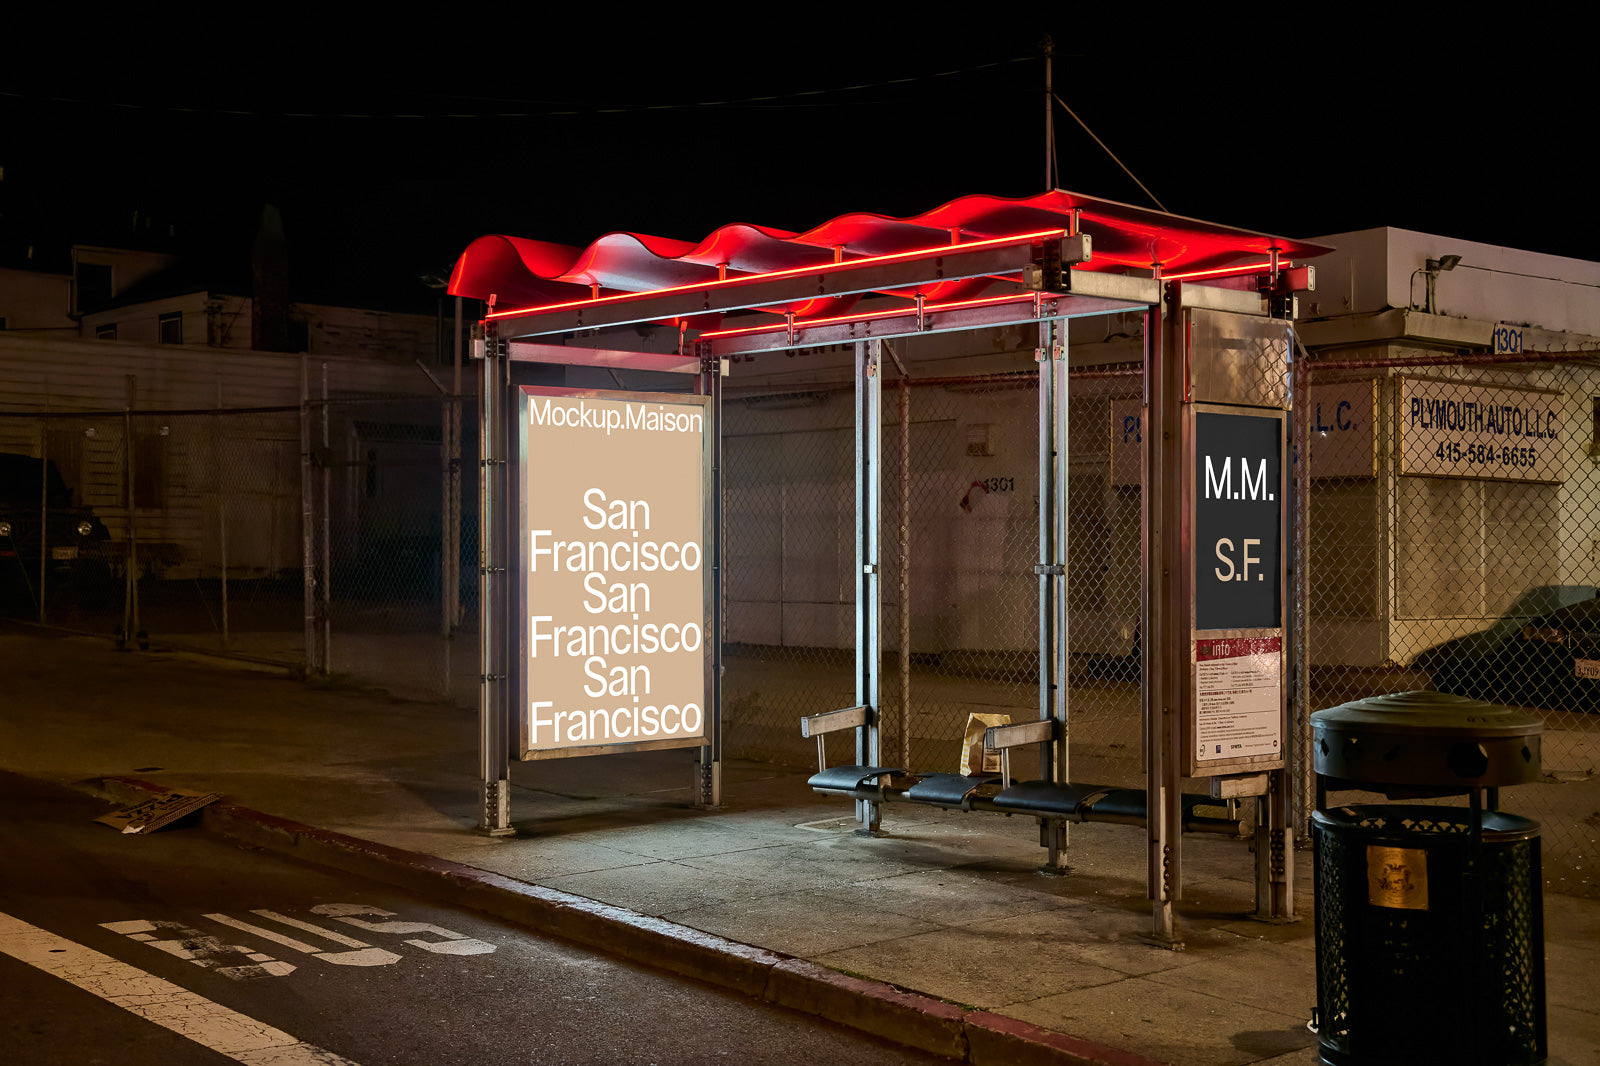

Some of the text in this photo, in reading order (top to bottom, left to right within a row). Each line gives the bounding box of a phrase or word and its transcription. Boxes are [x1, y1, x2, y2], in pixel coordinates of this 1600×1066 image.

[1495, 328, 1523, 353] 1301
[530, 398, 703, 435] Mockup.Maison
[1411, 397, 1483, 433] PLYMOUTH
[1487, 404, 1523, 436] AUTO
[1435, 441, 1536, 467] 415-584-6655
[1205, 455, 1274, 501] M.M.
[583, 488, 650, 530] San
[531, 530, 701, 572] Francisco
[1214, 537, 1264, 582] S.F.
[583, 572, 650, 613] San
[531, 613, 701, 657] Francisco
[1212, 640, 1230, 656] info
[583, 656, 650, 698] San
[531, 696, 702, 744] Francisco
